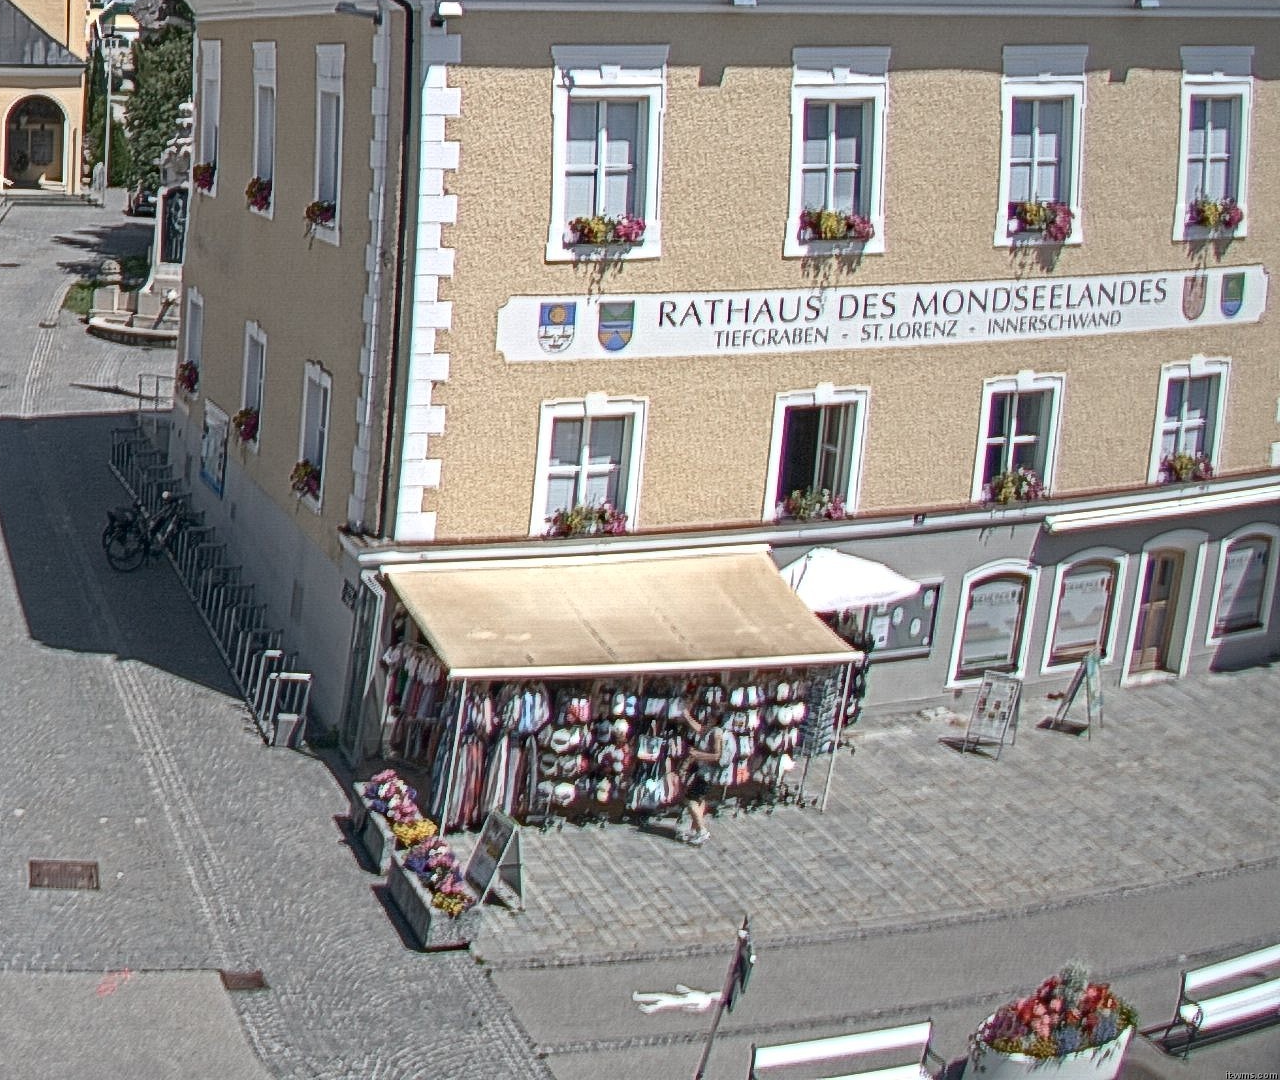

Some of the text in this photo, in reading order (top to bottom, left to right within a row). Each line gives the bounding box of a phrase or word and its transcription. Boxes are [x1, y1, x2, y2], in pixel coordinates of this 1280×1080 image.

[658, 277, 1169, 327] RATHAUS DES MONDSEELANDES
[714, 326, 829, 349] TIEFGRABEN
[860, 322, 884, 343] ST.
[889, 319, 960, 340] LORENZ
[987, 309, 1123, 336] INNERSCHWAND
